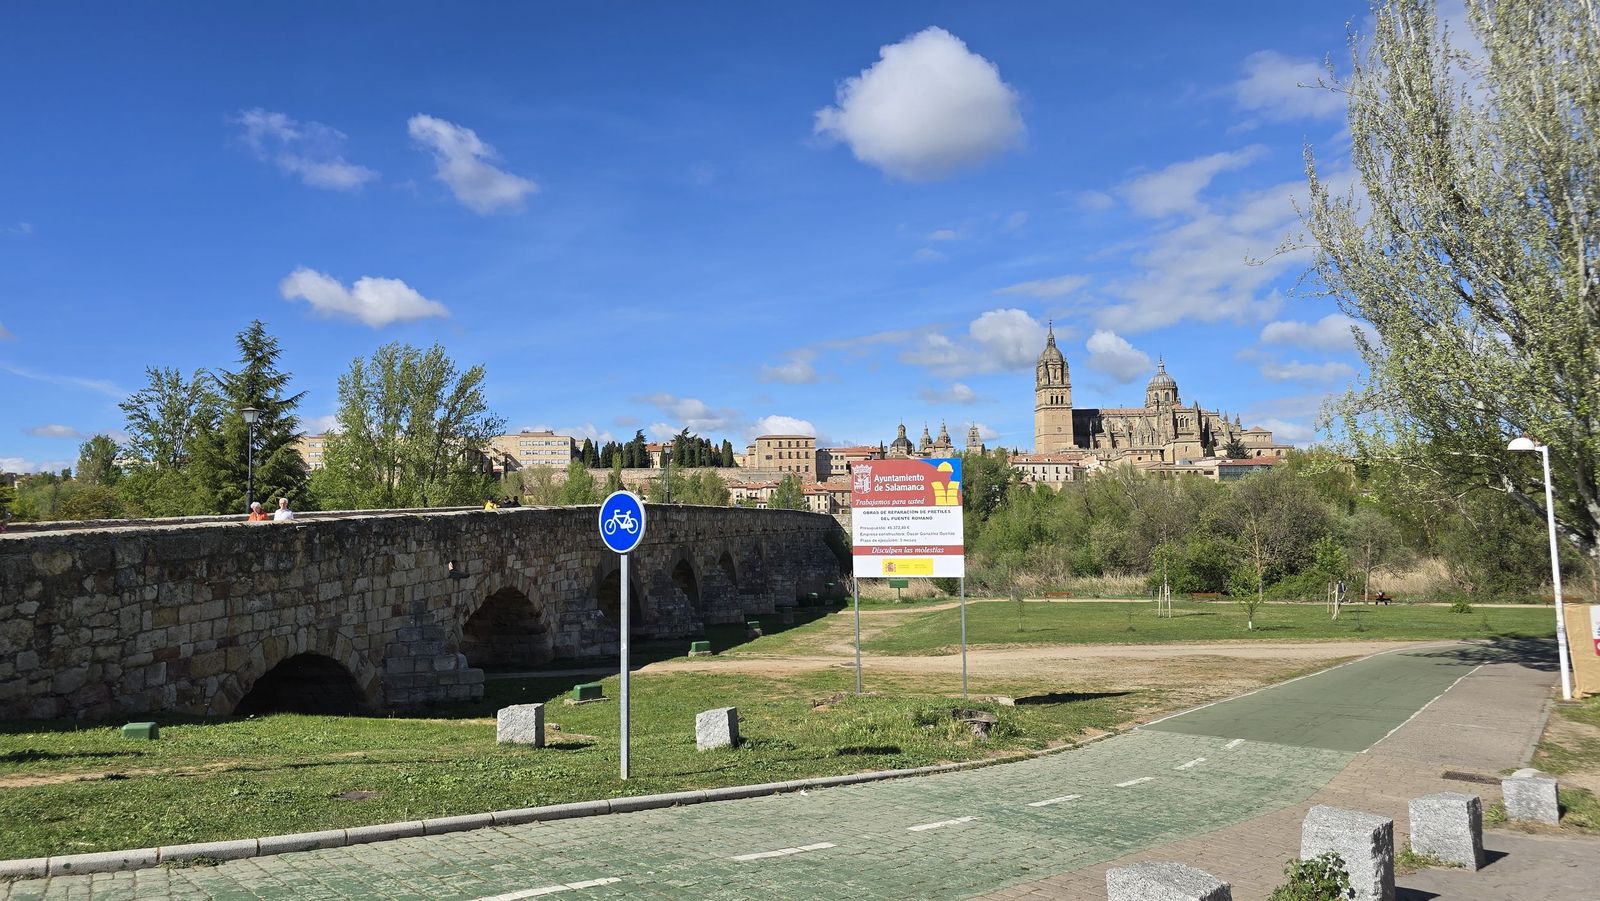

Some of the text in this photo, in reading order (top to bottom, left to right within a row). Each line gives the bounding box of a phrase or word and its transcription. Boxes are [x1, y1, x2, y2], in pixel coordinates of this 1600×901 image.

[874, 474, 924, 483] Ayuntamiento
[874, 484, 924, 492] de Salamanca
